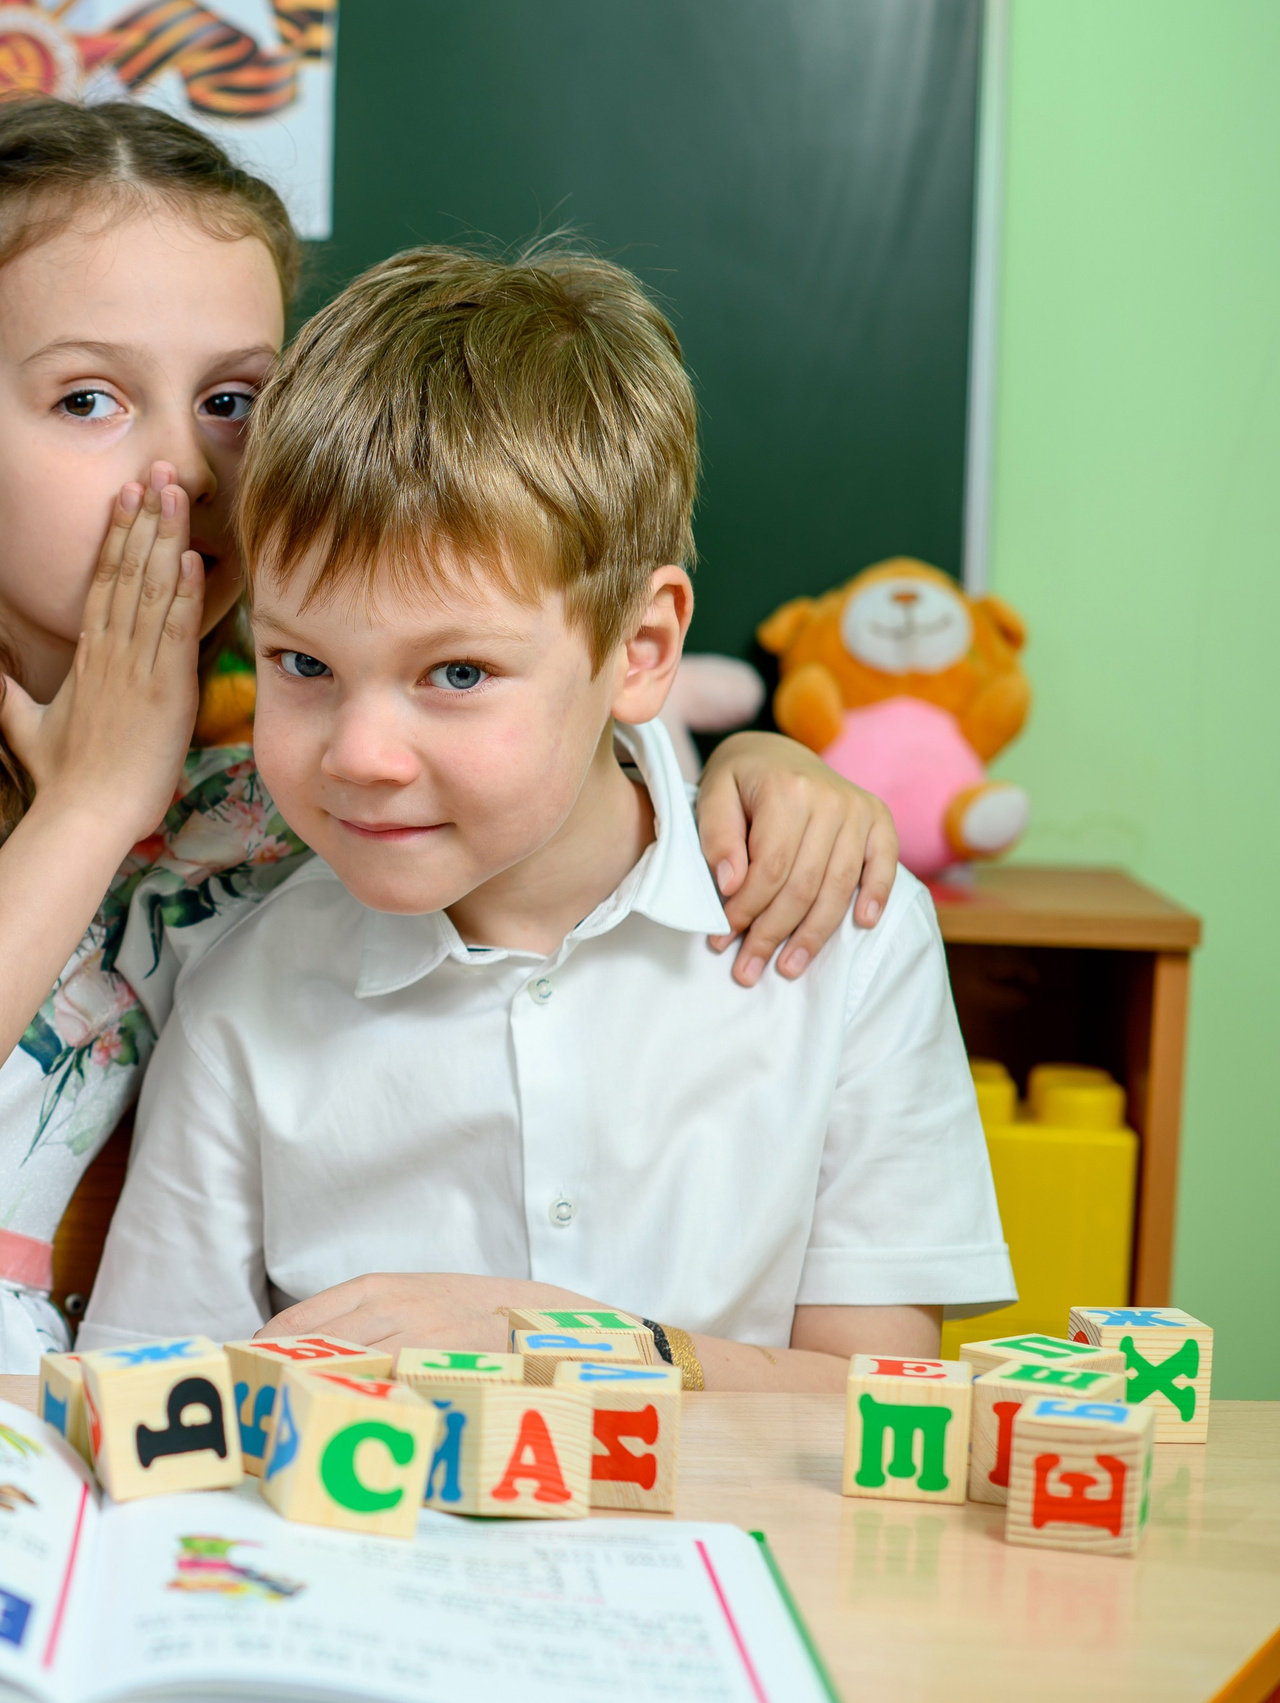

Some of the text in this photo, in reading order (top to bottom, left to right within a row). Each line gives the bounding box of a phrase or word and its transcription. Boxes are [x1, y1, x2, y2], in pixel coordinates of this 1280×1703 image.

[540, 1311, 636, 1330] П
[1086, 1310, 1186, 1327] Ж
[249, 1338, 367, 1360] Ы
[525, 1334, 613, 1351] Р
[990, 1337, 1101, 1359] П
[868, 1358, 948, 1379] Е
[1119, 1335, 1200, 1422] Х
[136, 1377, 227, 1468] Ь
[320, 1420, 415, 1514] С
[490, 1409, 572, 1503] А
[1032, 1453, 1127, 1537] Е
